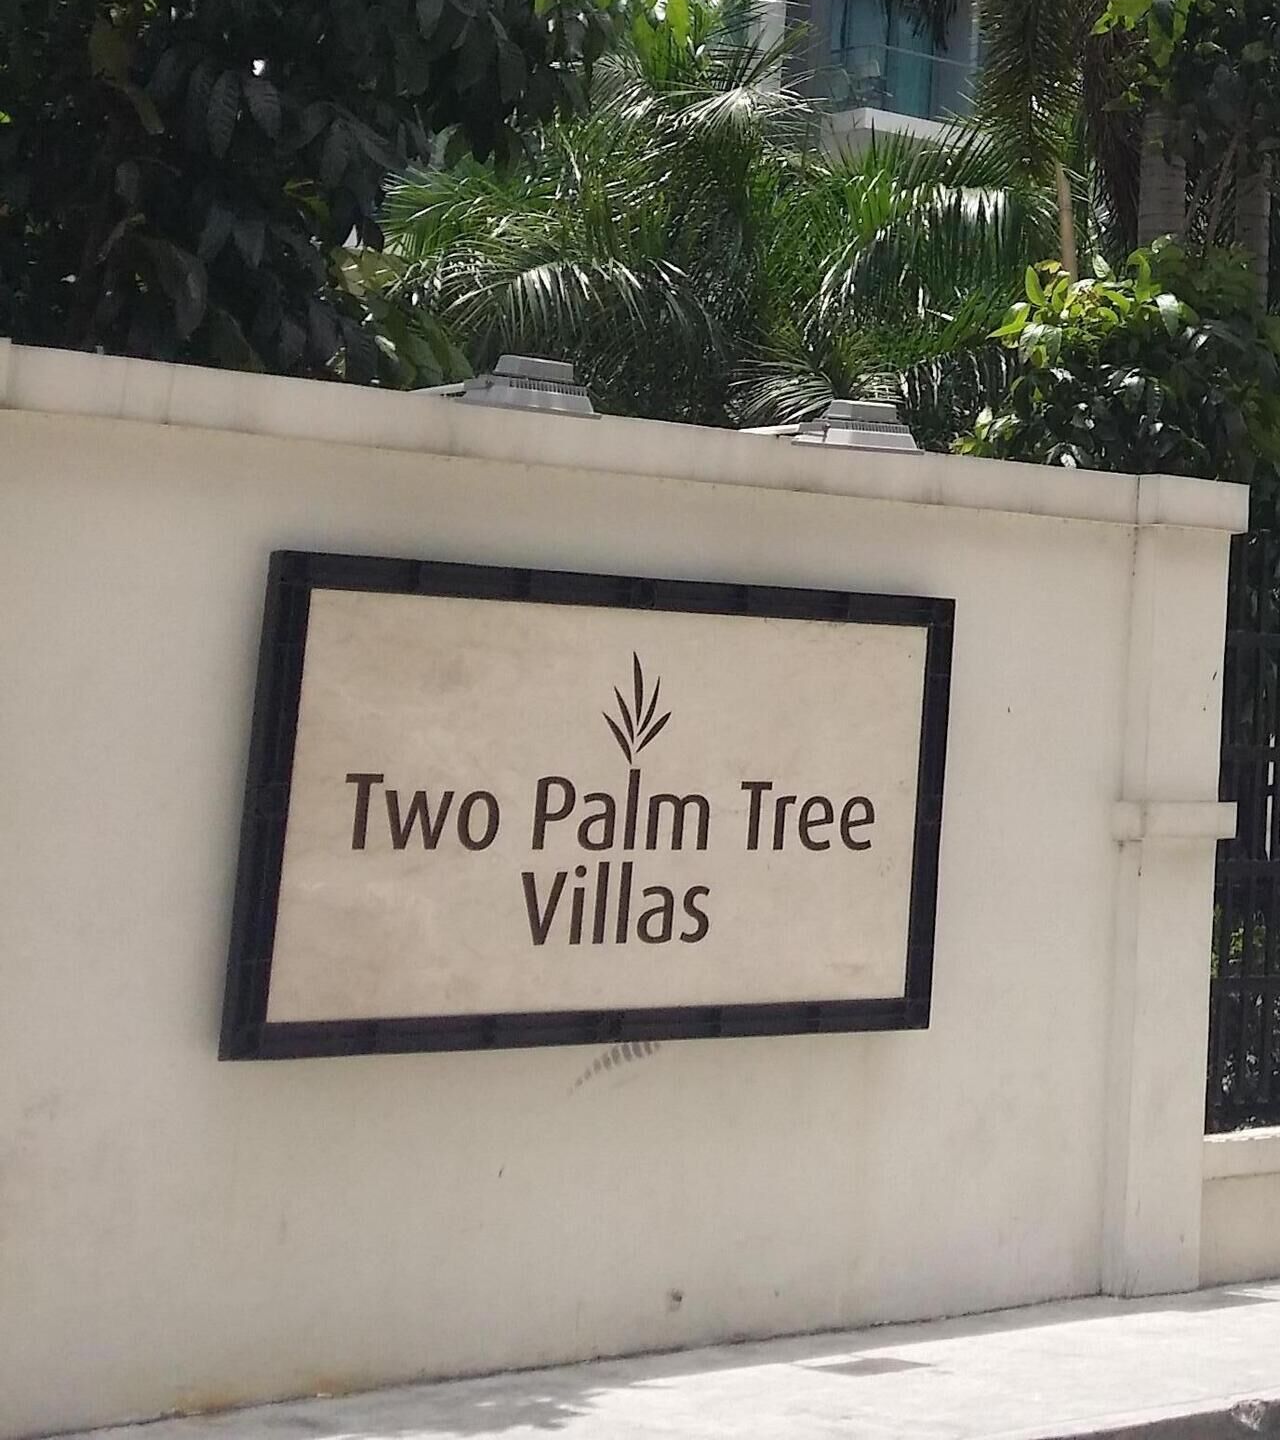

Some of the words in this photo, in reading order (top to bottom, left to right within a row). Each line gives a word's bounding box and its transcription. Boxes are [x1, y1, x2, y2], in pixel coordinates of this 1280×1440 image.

[345, 773, 500, 851] Two
[531, 768, 710, 851] Palm
[740, 780, 876, 851] Tree
[521, 861, 711, 946] Villas
